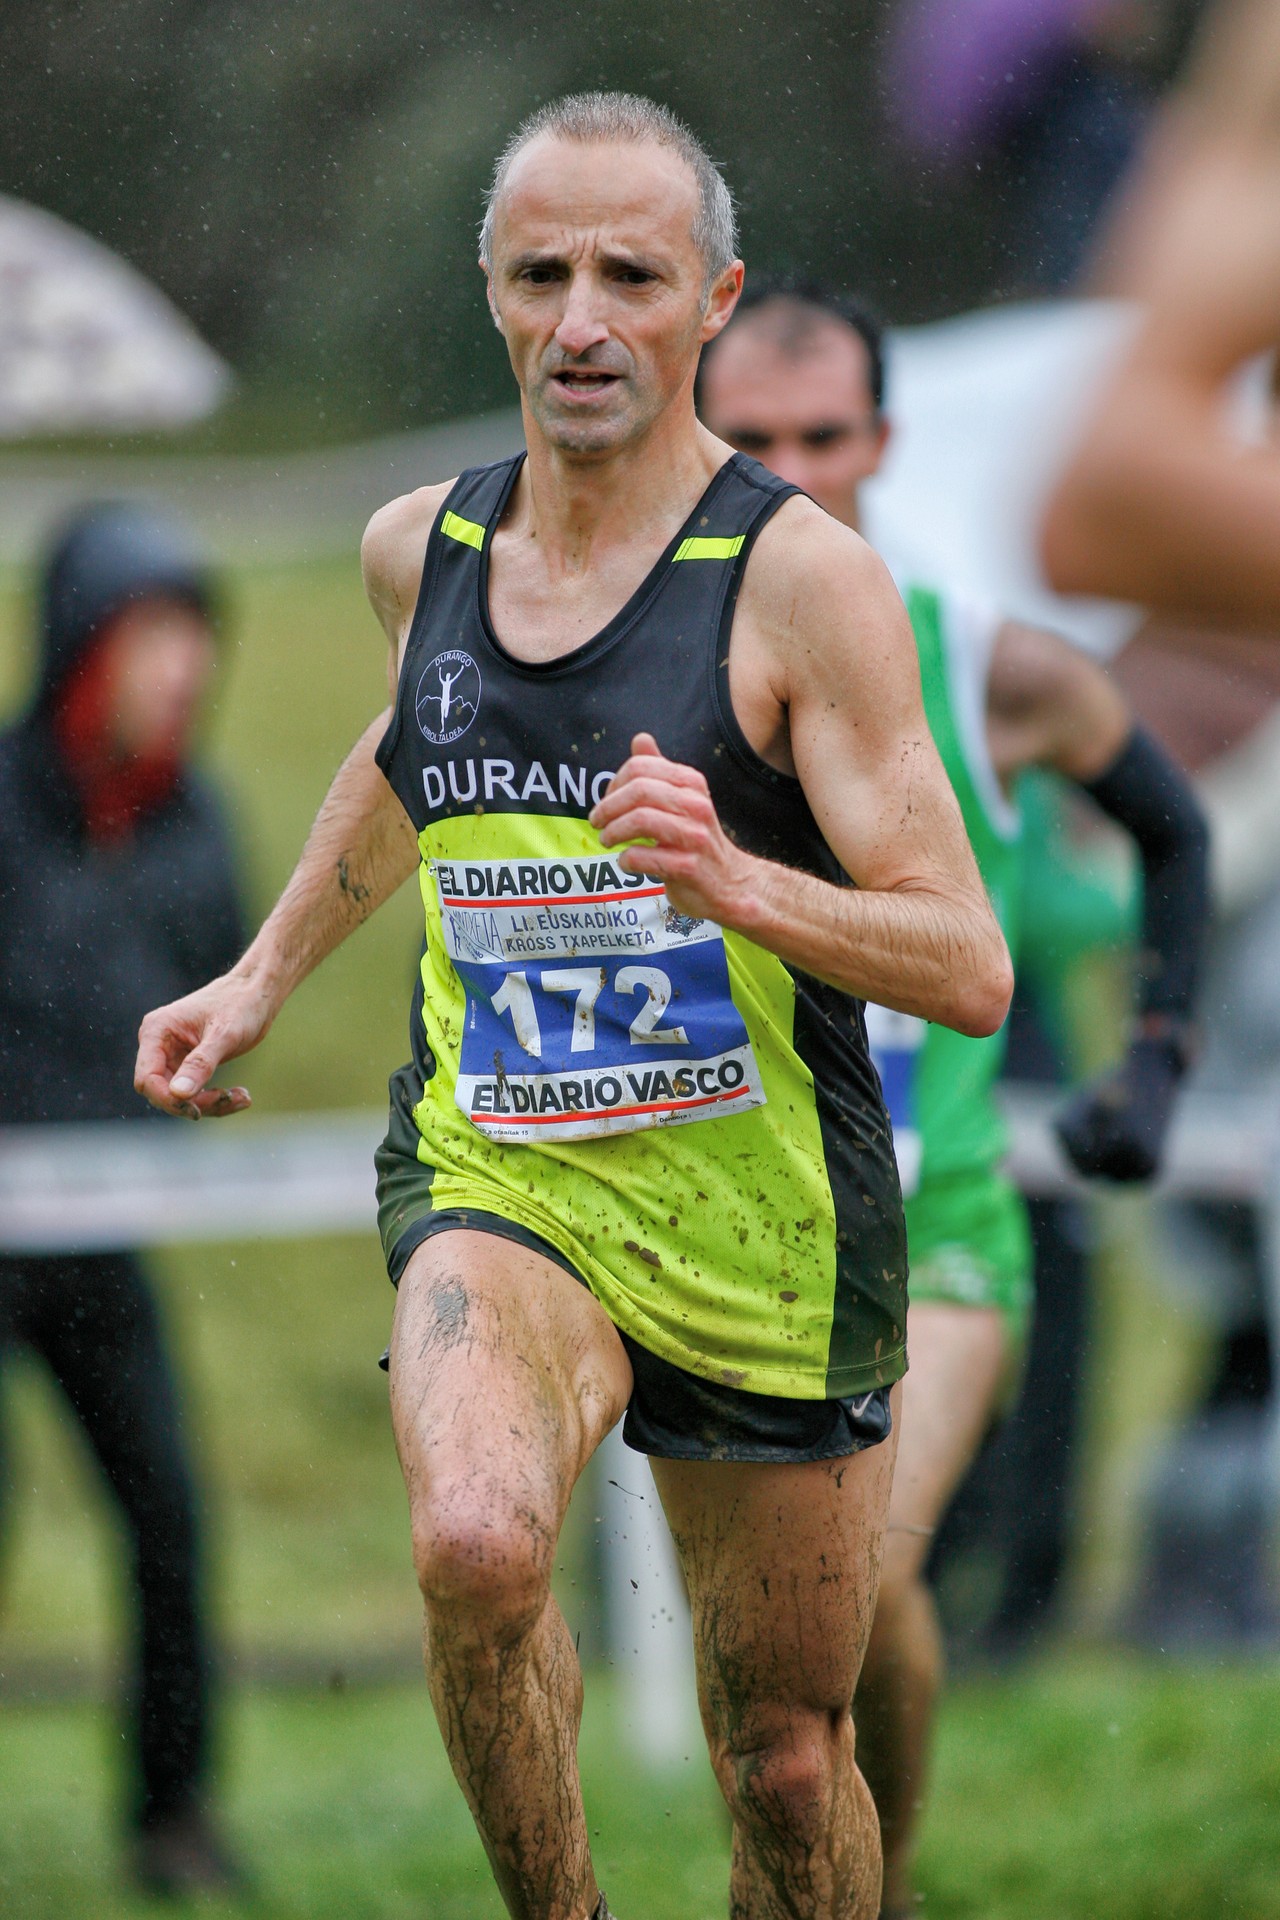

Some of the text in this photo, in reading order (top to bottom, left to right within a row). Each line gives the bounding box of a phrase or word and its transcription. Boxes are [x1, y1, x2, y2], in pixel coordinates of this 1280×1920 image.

[434, 652, 472, 667] DURANGO
[422, 724, 463, 742] KIROL TALDEA
[422, 758, 617, 809] DURAN
[437, 861, 665, 897] EL DIARIO VAS
[537, 908, 639, 931] EUSKADIKO
[505, 935, 557, 953] KROSS
[560, 930, 655, 951] TXAPELKETA
[490, 966, 690, 1057] 172
[471, 1059, 745, 1114] EL DIARIO VASCO
